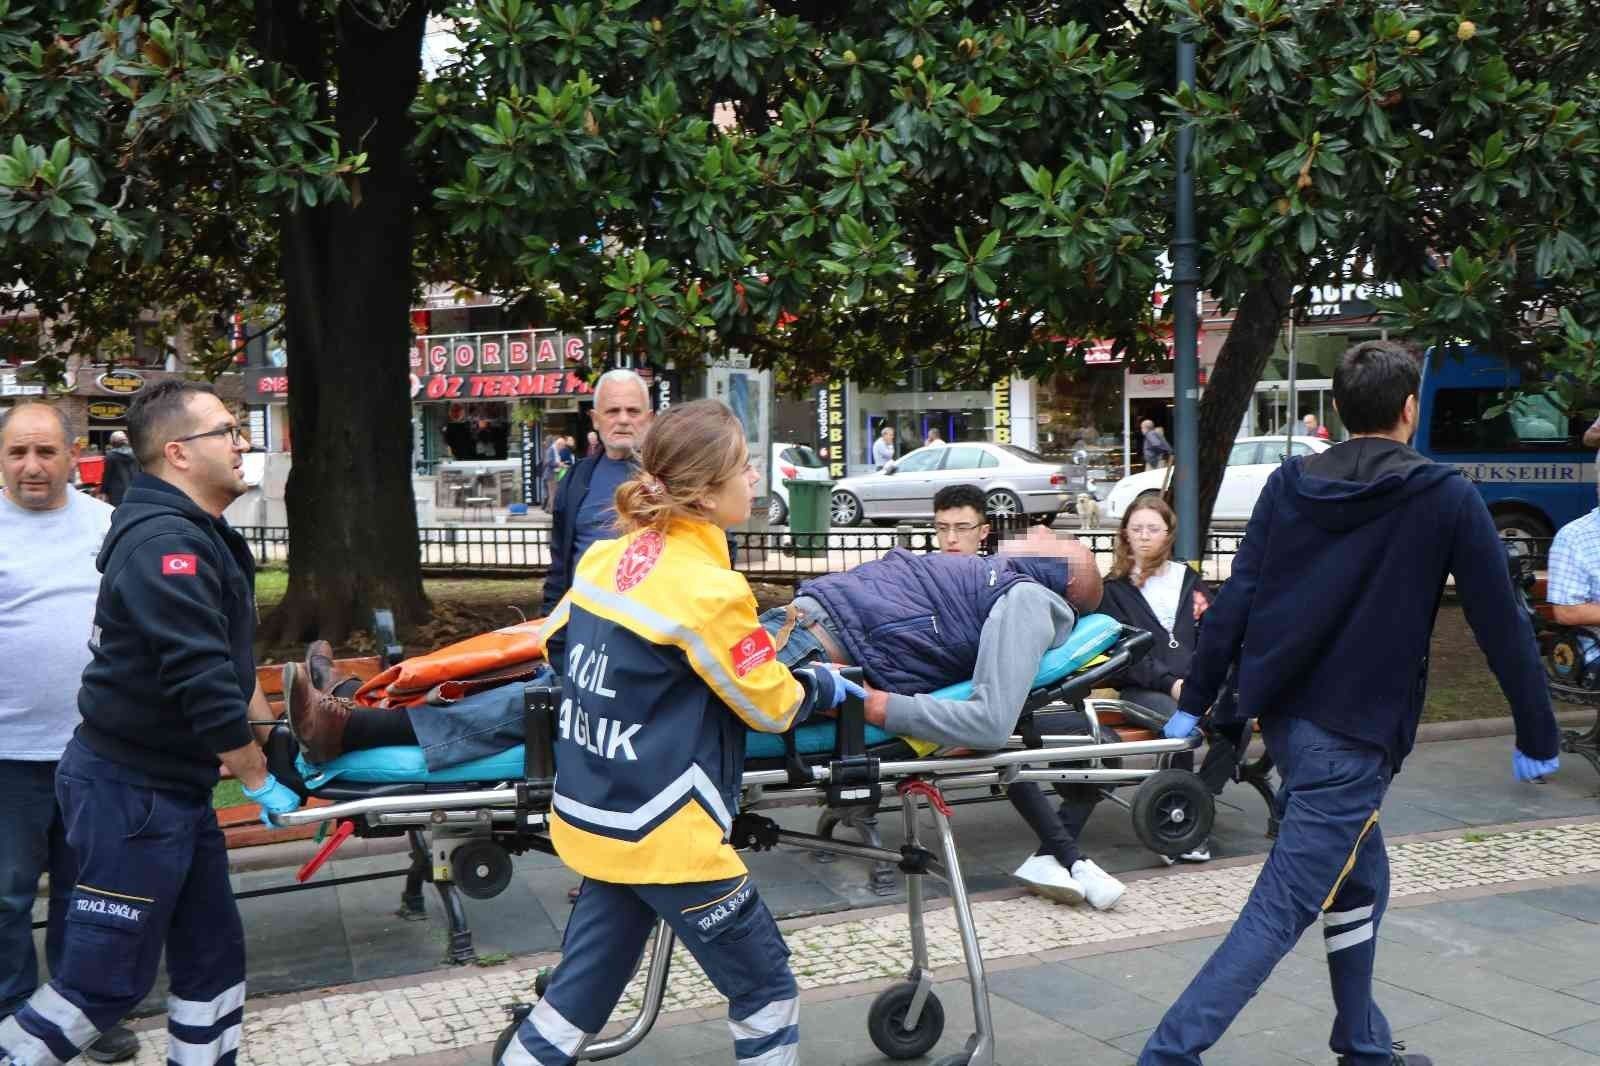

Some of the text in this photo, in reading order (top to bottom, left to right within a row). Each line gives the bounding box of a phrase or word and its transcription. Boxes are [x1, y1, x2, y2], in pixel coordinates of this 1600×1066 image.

[426, 373, 464, 399] ÖZ
[469, 373, 563, 397] TERME
[818, 389, 828, 439] vodafone
[559, 697, 643, 761] AĞLIK
